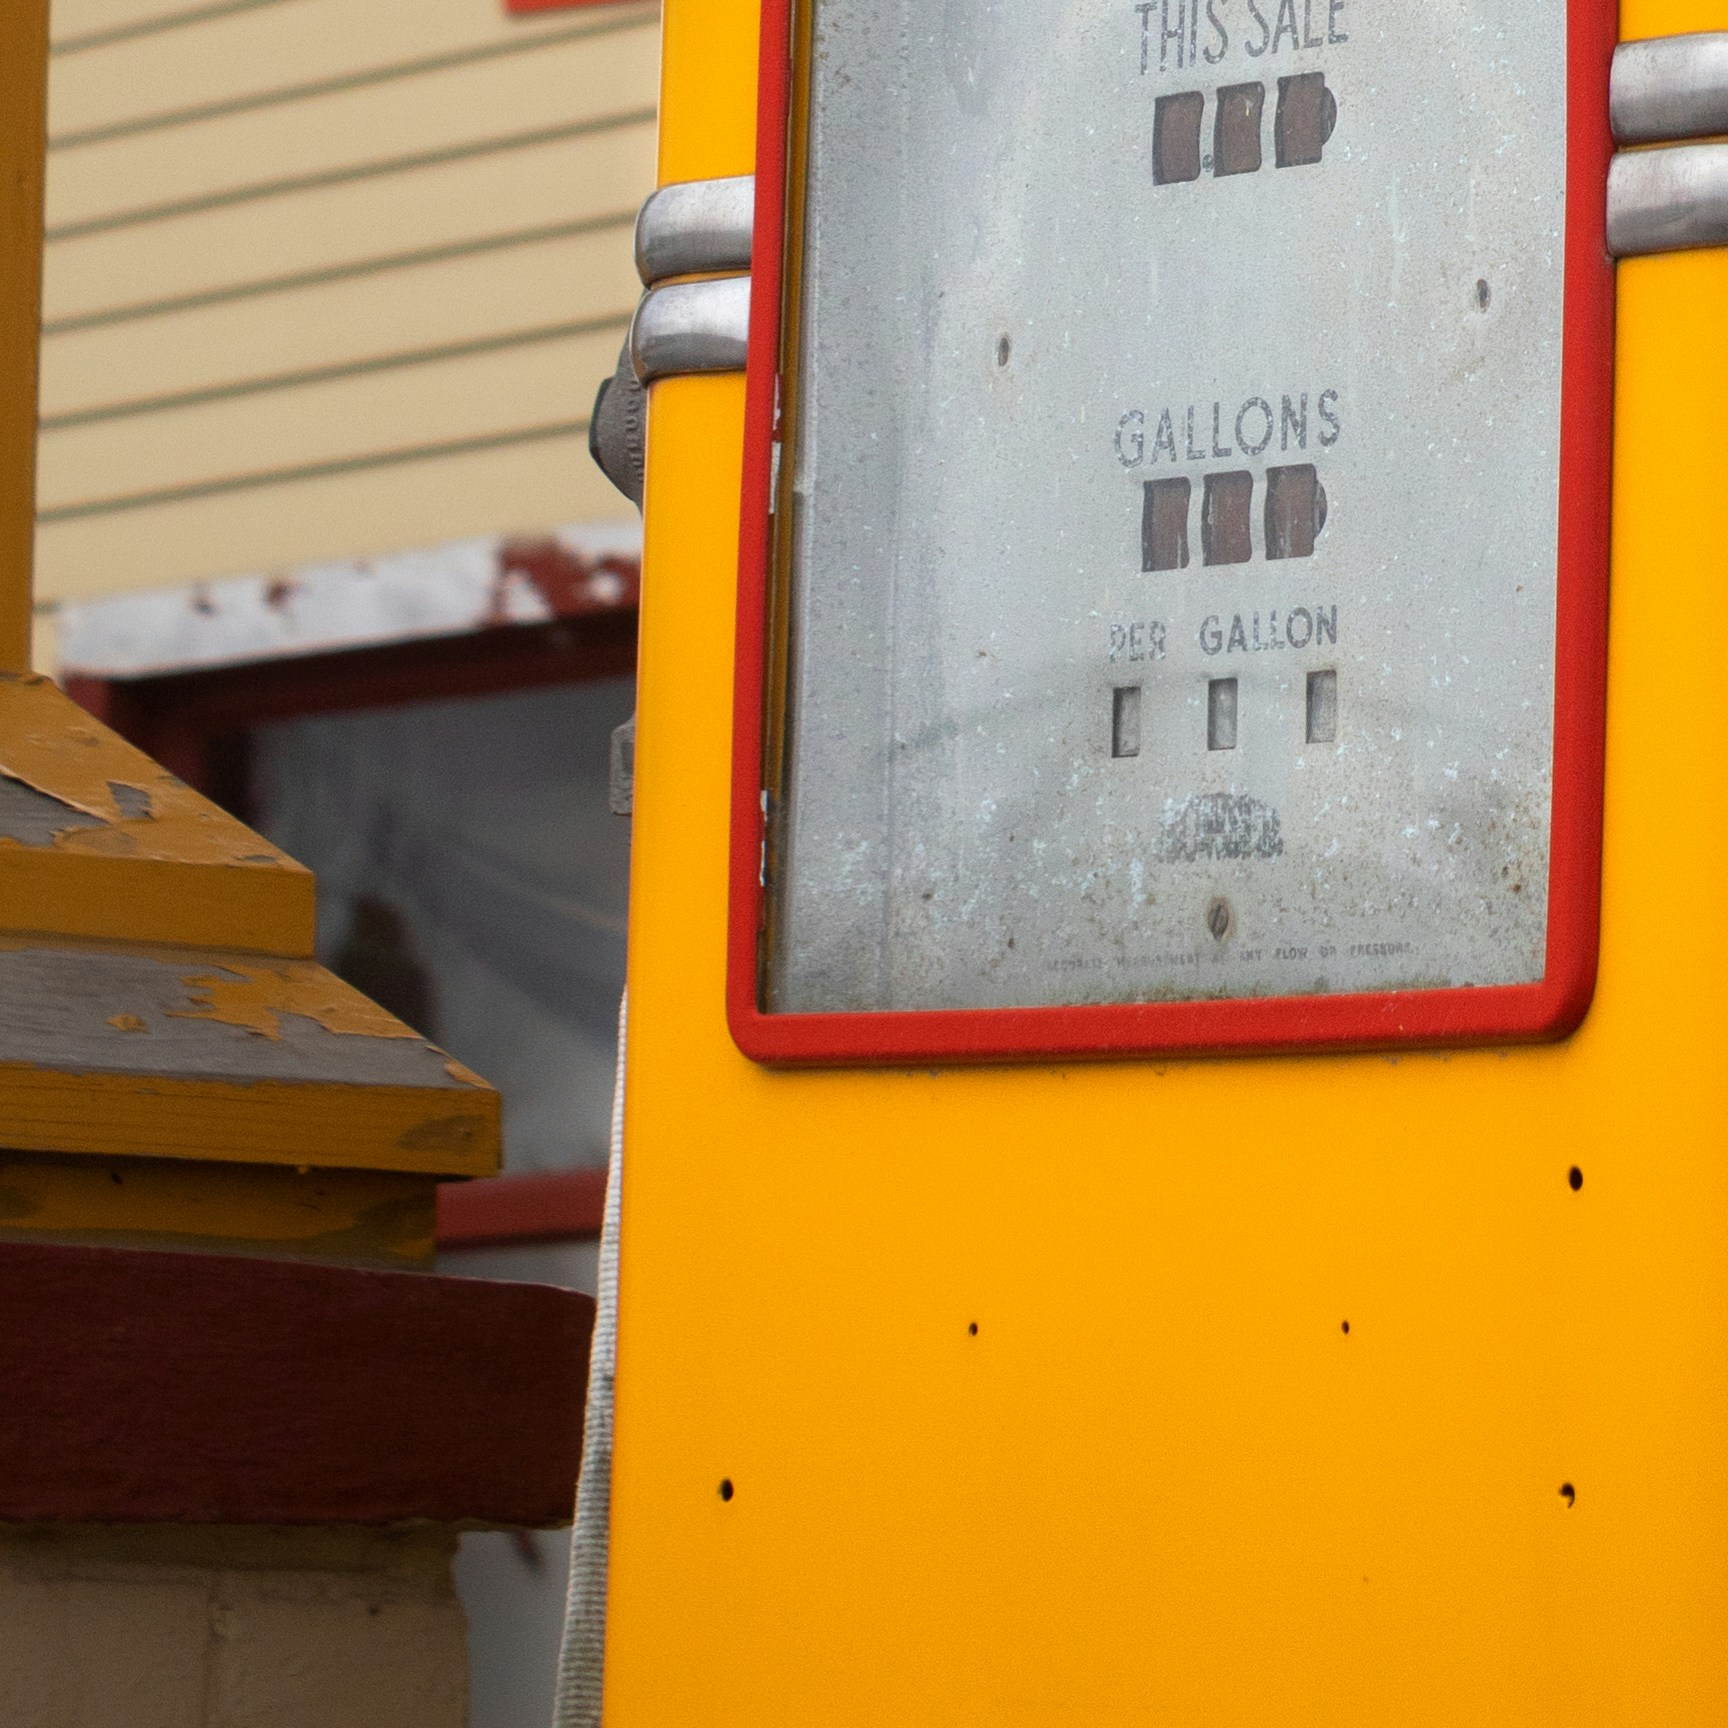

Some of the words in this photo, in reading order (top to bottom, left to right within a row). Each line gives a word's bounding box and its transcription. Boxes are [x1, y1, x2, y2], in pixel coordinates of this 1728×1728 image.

[1113, 388, 1341, 469] GALLONS
[1109, 620, 1167, 663] PER
[1199, 604, 1338, 656] GALLON
